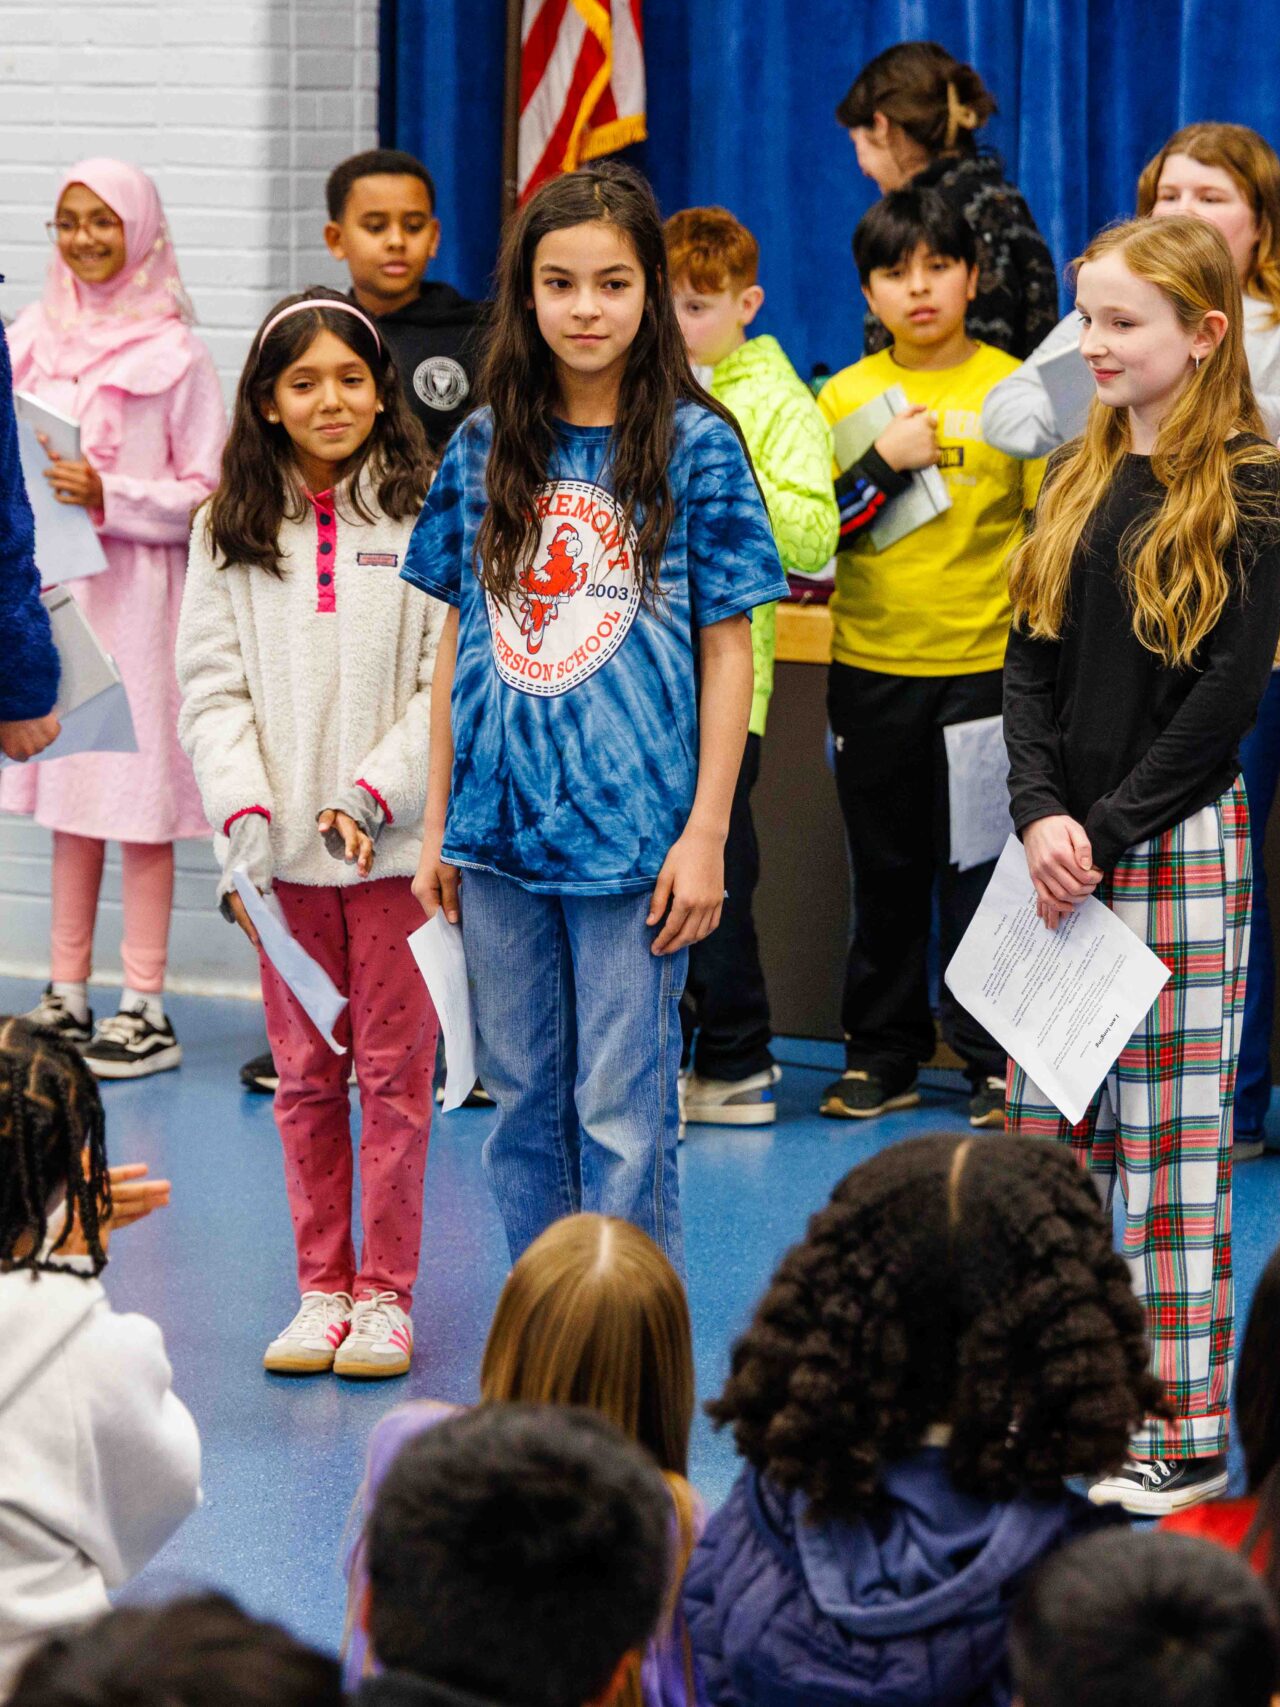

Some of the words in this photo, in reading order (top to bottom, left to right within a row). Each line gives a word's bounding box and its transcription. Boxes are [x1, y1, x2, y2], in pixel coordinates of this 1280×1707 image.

[525, 494, 630, 570] REMONT
[585, 584, 629, 600] 2003
[495, 601, 554, 681] ERSION
[557, 611, 621, 678] SCHOOL
